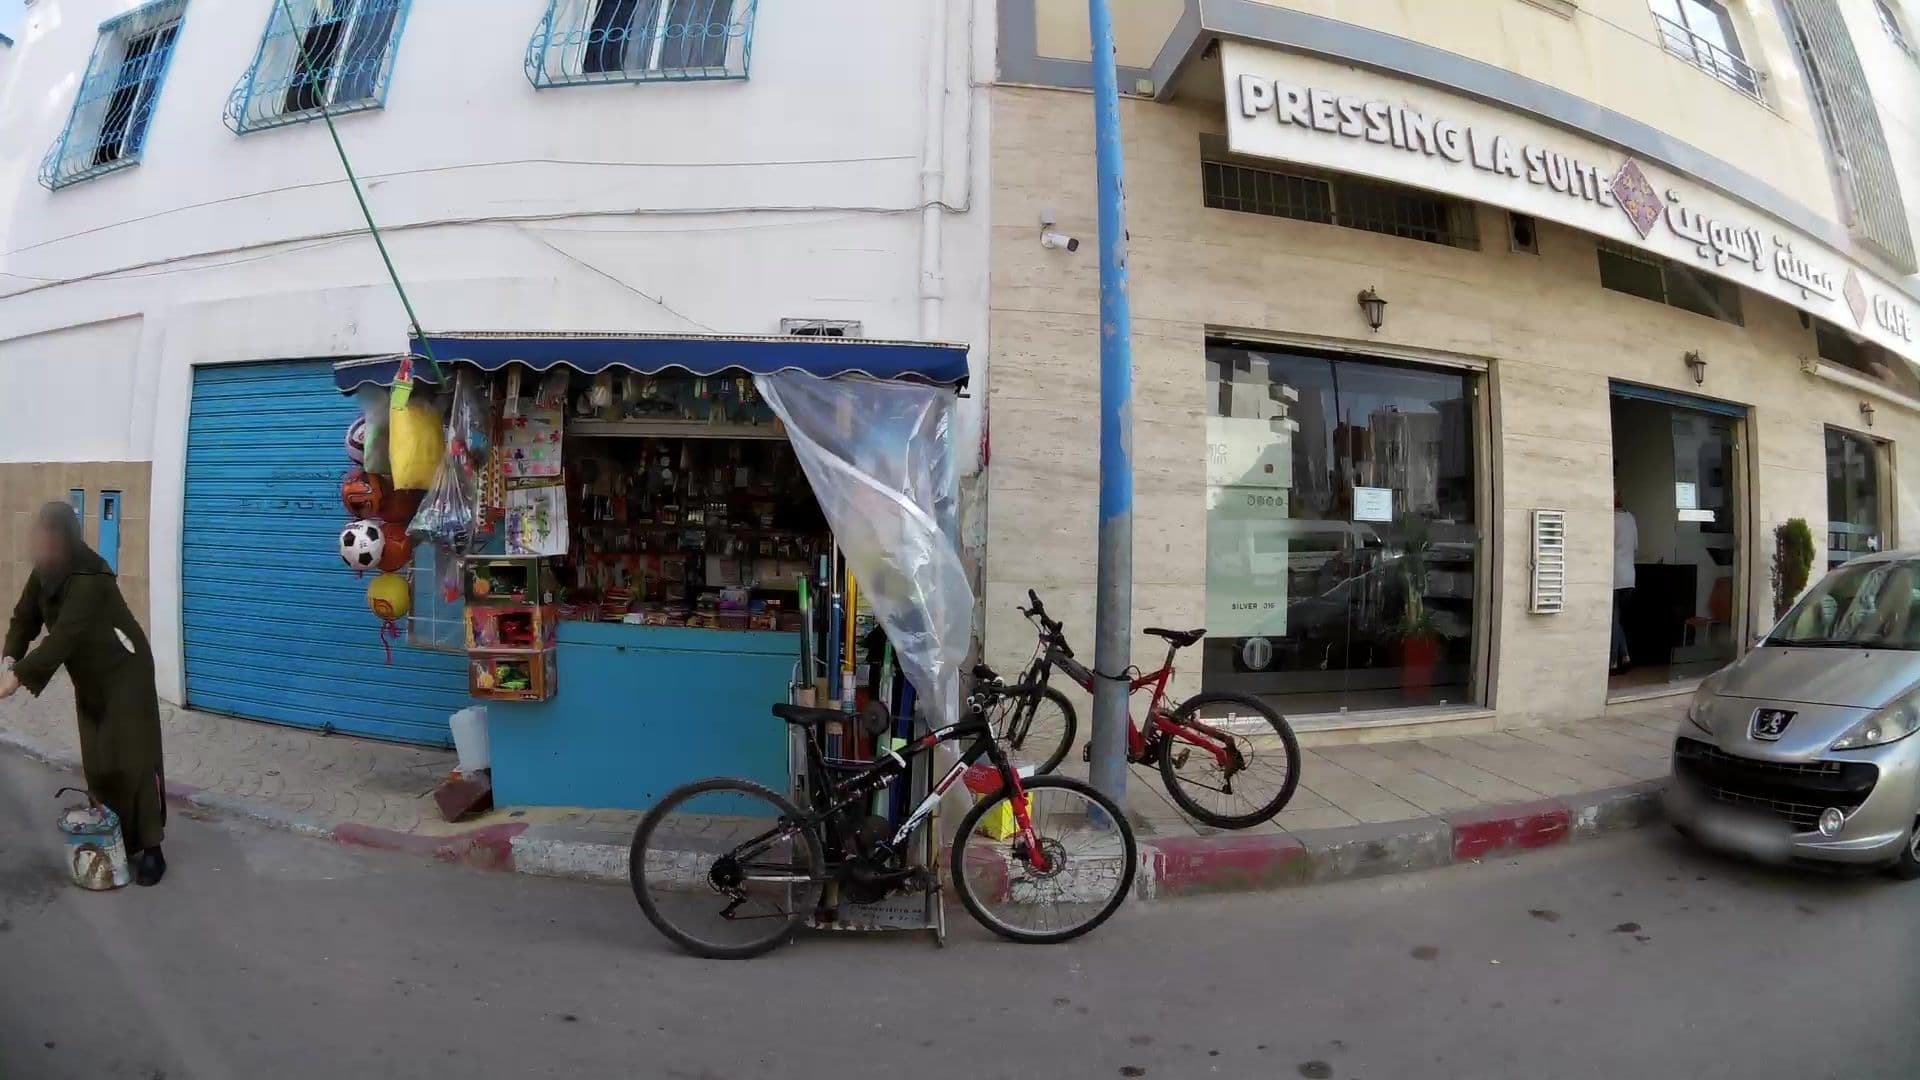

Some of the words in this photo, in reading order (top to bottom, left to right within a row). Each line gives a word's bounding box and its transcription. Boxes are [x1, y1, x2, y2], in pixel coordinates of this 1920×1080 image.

[1239, 74, 1464, 162] PRESSING
[1467, 127, 1520, 177] LA
[1523, 143, 1614, 208] SUITE
[1232, 602, 1258, 610] SILVER
